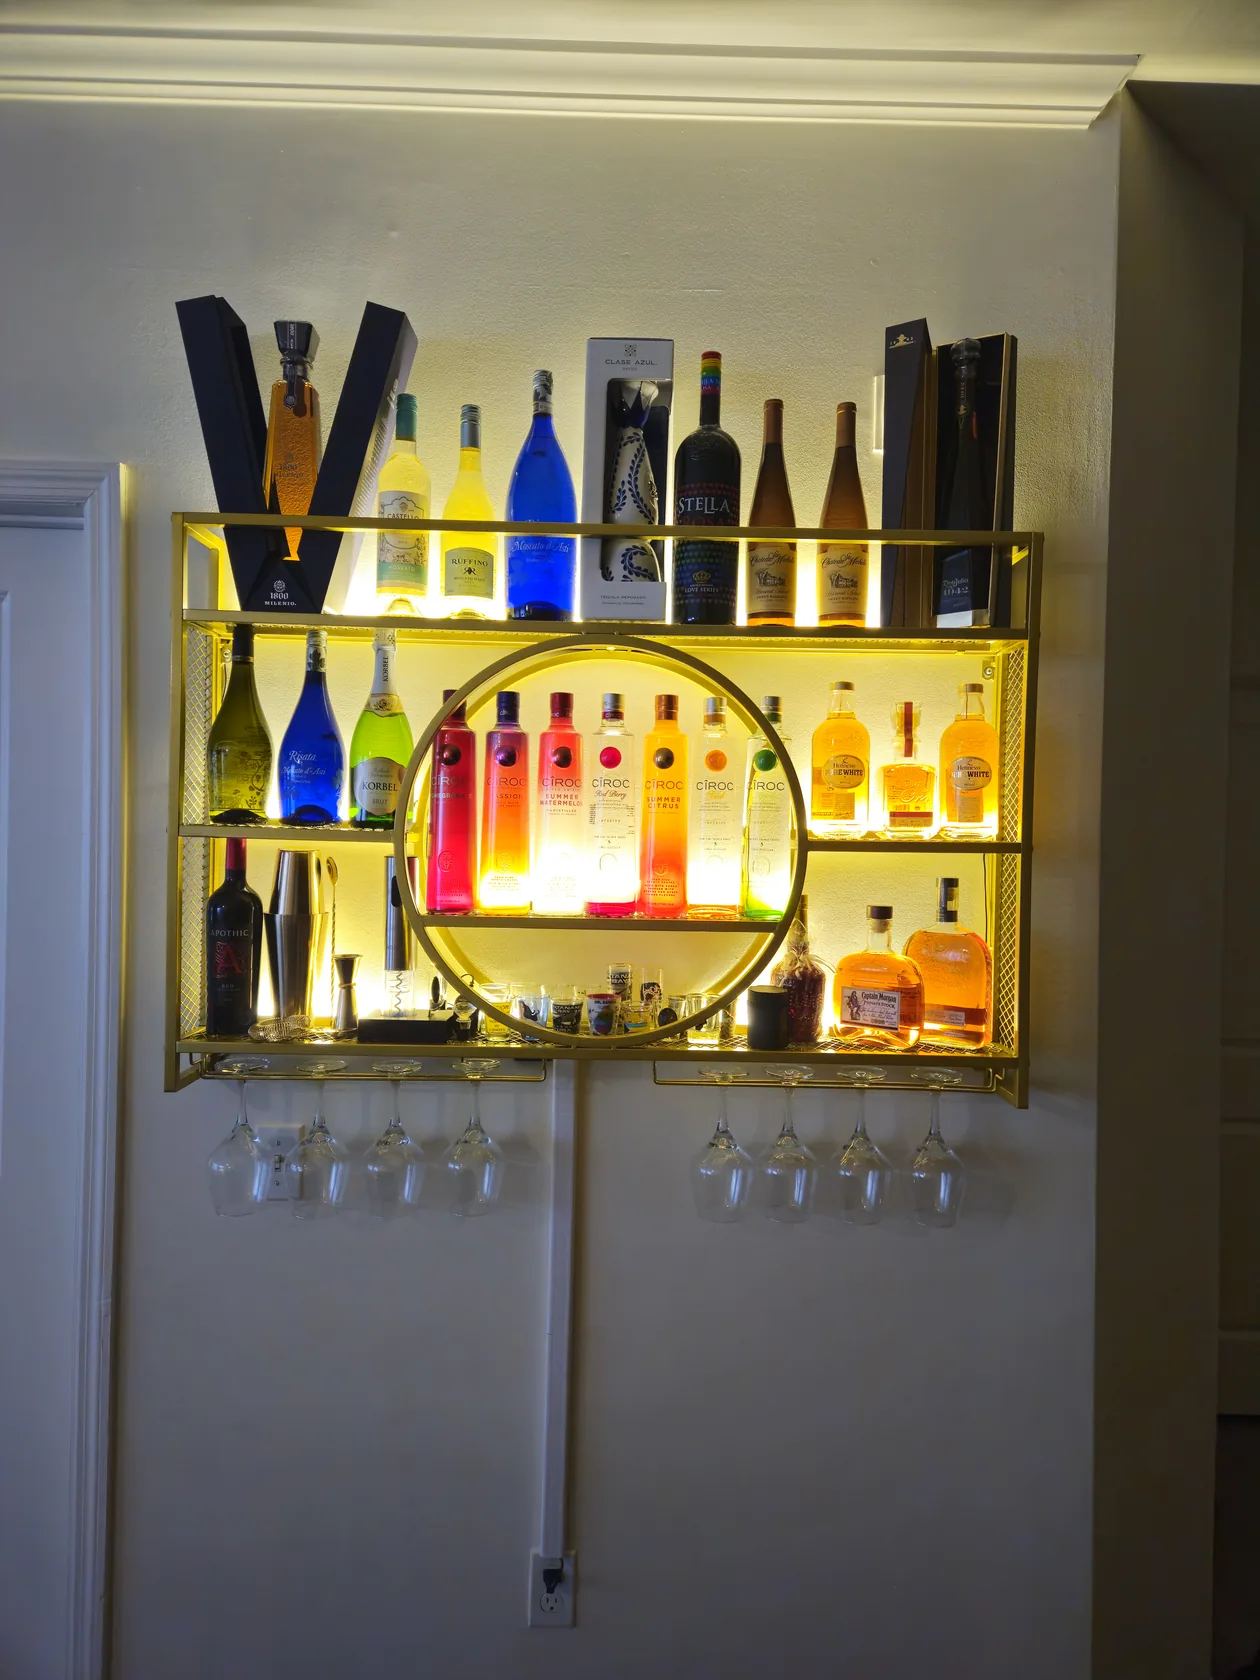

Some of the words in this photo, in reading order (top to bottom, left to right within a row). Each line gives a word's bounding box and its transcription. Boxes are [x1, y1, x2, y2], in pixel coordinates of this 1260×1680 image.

[678, 496, 730, 514] STELLA
[451, 558, 489, 567] RUFFINO
[270, 592, 289, 600] 1800
[288, 750, 317, 764] Risata
[843, 769, 864, 777] WHITE
[362, 781, 398, 792] KORBEL
[486, 776, 527, 787] CROC
[542, 775, 582, 788] CÎROC
[591, 776, 630, 789] CÎROC
[645, 778, 684, 790] CÎROC
[696, 779, 734, 791] CÎROC
[747, 779, 785, 791] CÎROC
[594, 789, 609, 797] Red
[609, 789, 627, 800] Berry
[210, 928, 249, 937] APOTHIC
[861, 991, 880, 1001] Captain
[878, 992, 897, 1003] Morgan
